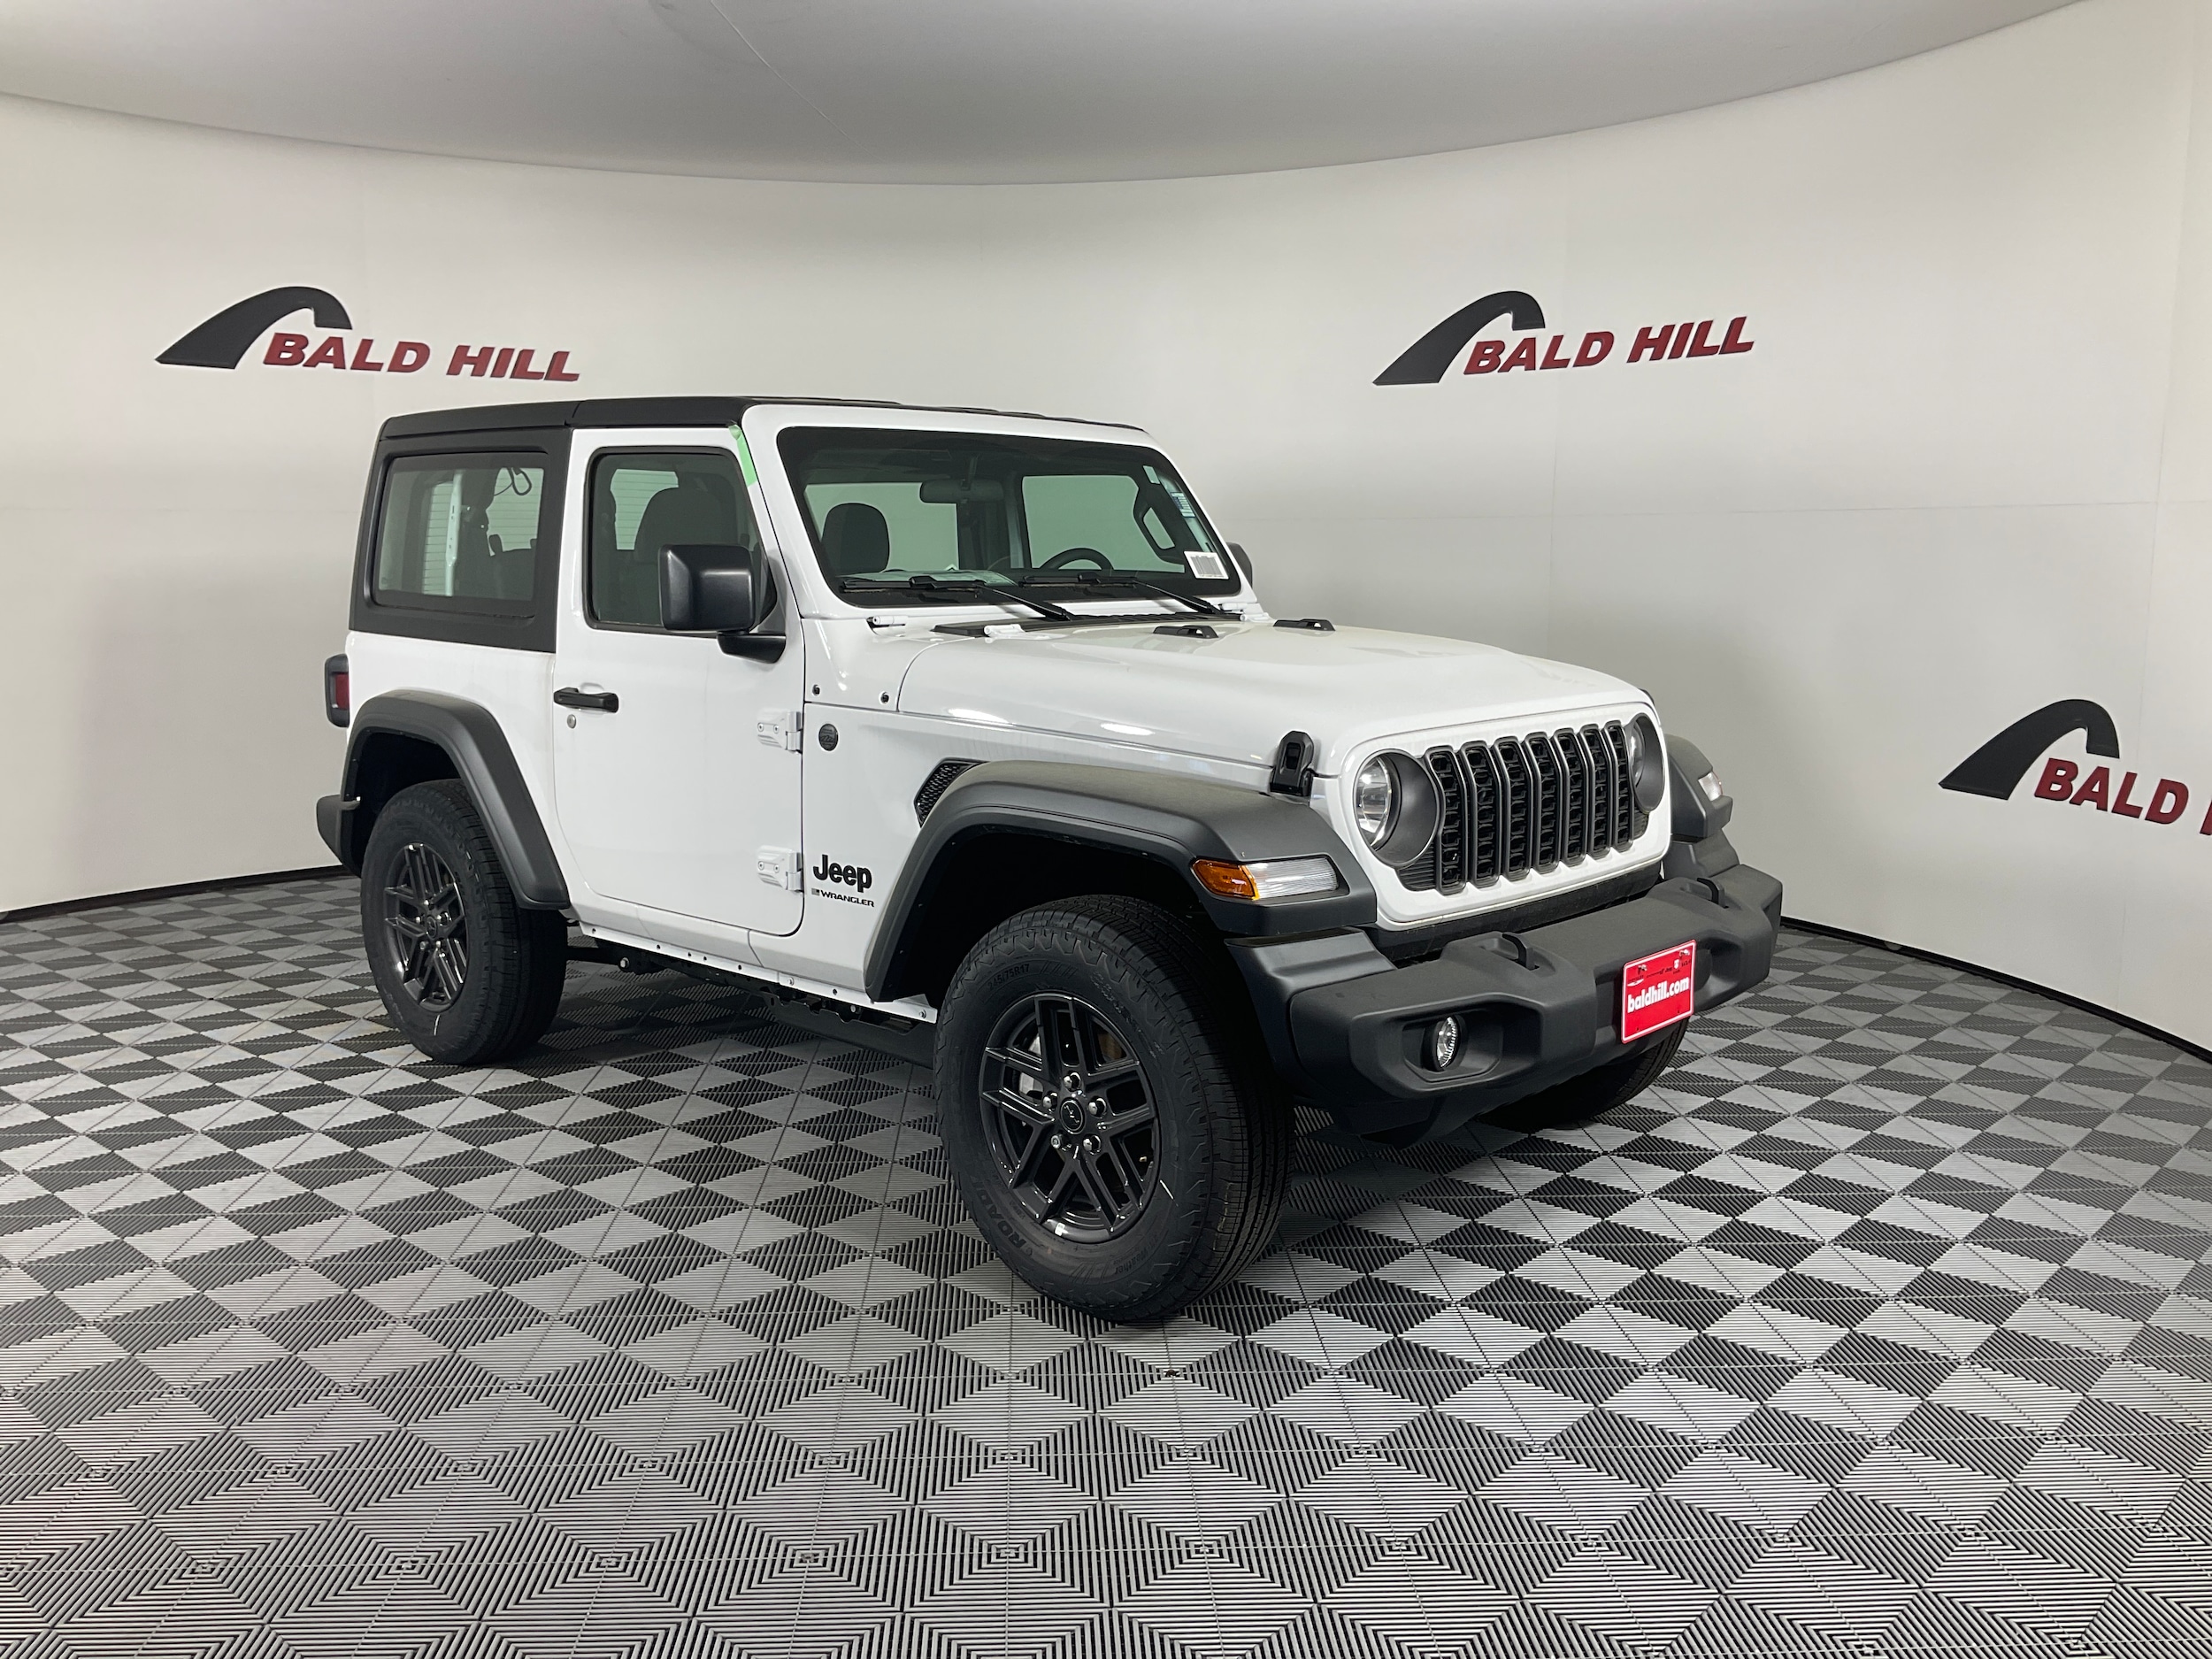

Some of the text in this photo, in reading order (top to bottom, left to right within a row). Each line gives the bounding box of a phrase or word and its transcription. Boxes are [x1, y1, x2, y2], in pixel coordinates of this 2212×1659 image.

[263, 332, 580, 381] BALD HILL
[1463, 316, 1755, 375] BALD HILL
[2034, 757, 2189, 825] BALD
[812, 854, 872, 893] Jeep
[820, 889, 875, 907] WRANGLER
[1627, 977, 1689, 1013] baldhill.com
